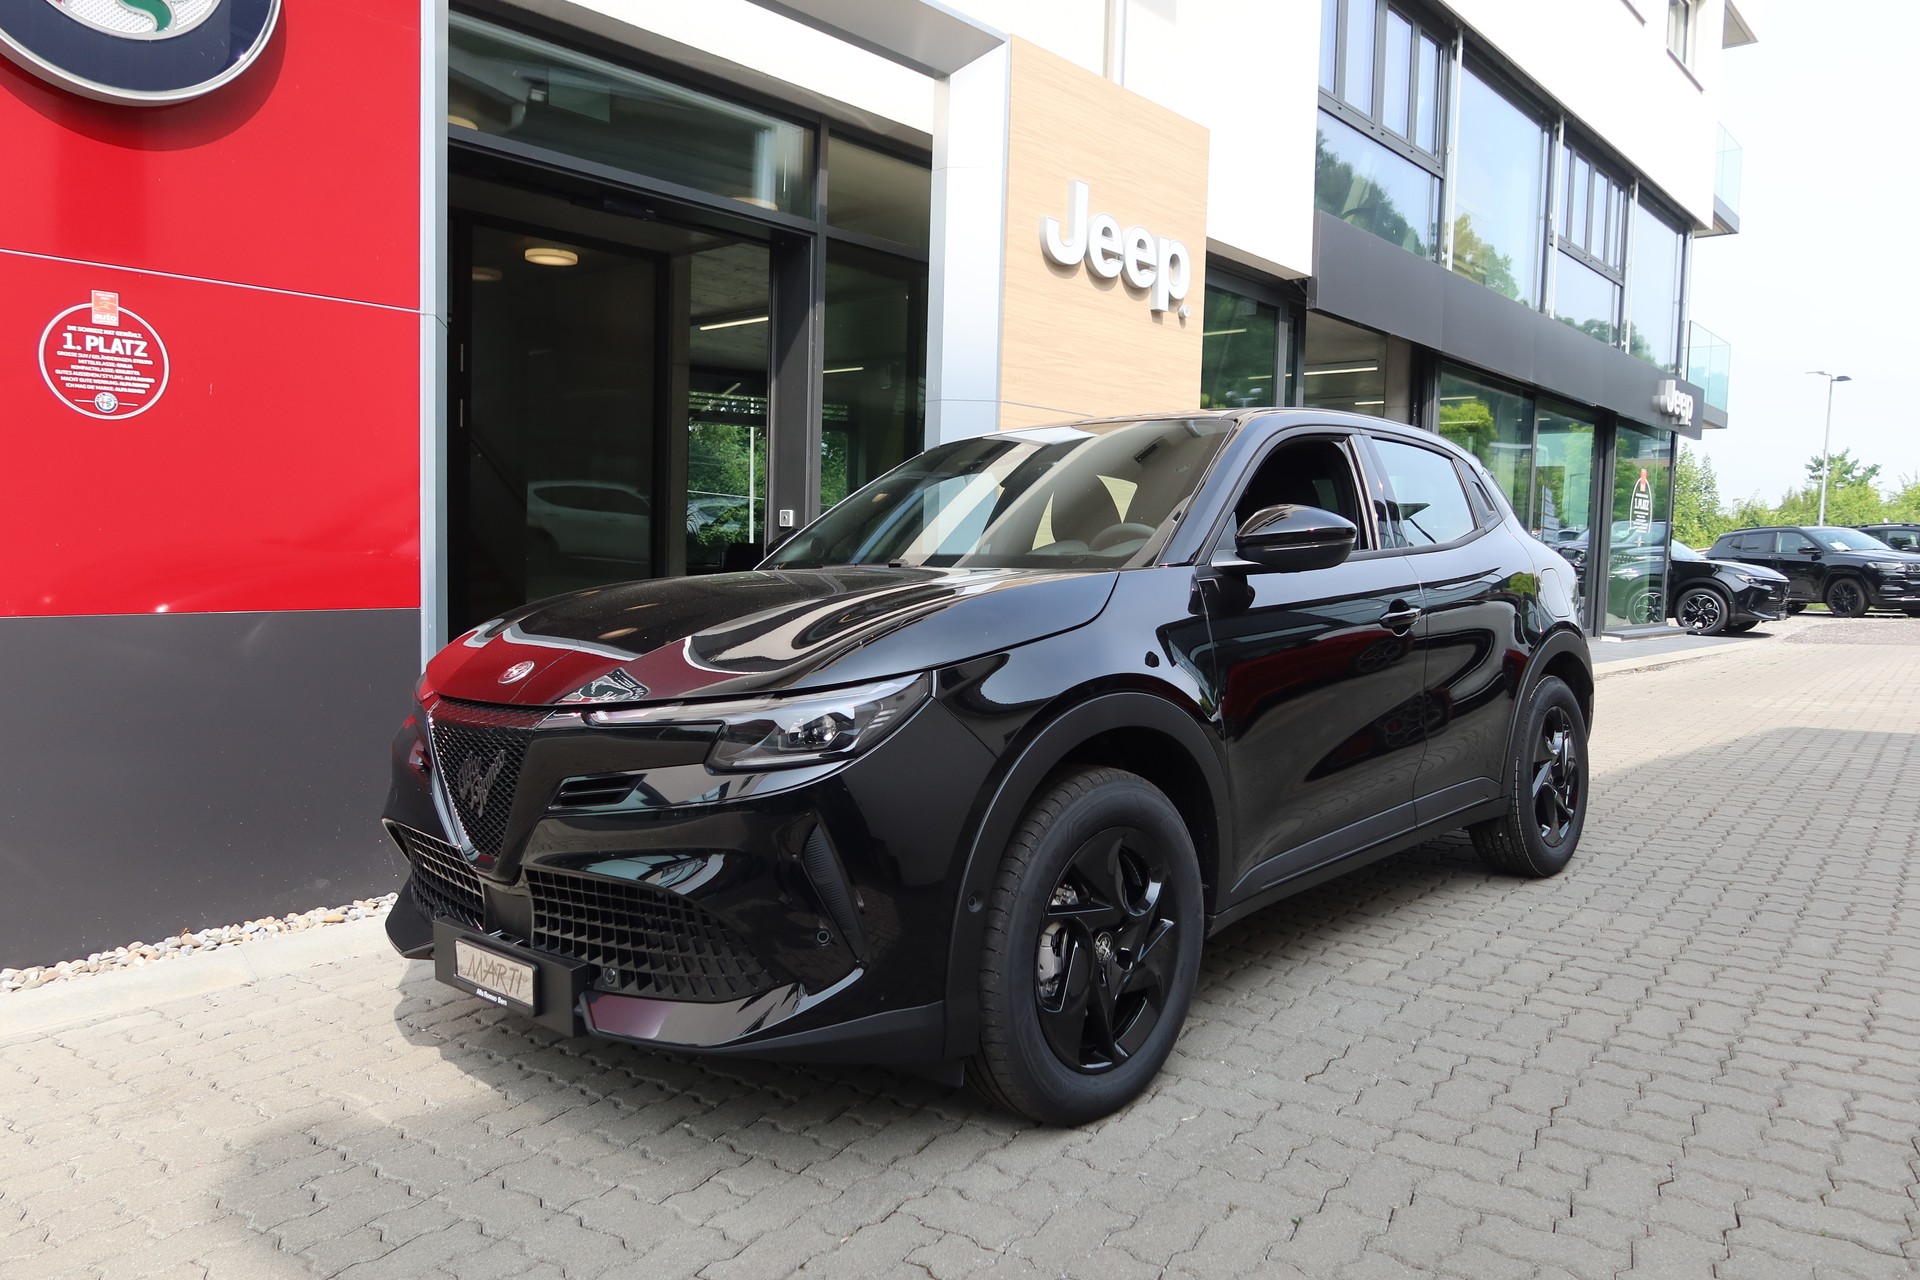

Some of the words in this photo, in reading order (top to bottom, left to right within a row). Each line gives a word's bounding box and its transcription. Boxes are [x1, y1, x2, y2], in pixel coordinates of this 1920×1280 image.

[1040, 179, 1191, 312] Jeep
[62, 332, 82, 350] 1.
[85, 334, 148, 357] PLATZ
[1659, 380, 1693, 425] Jeep
